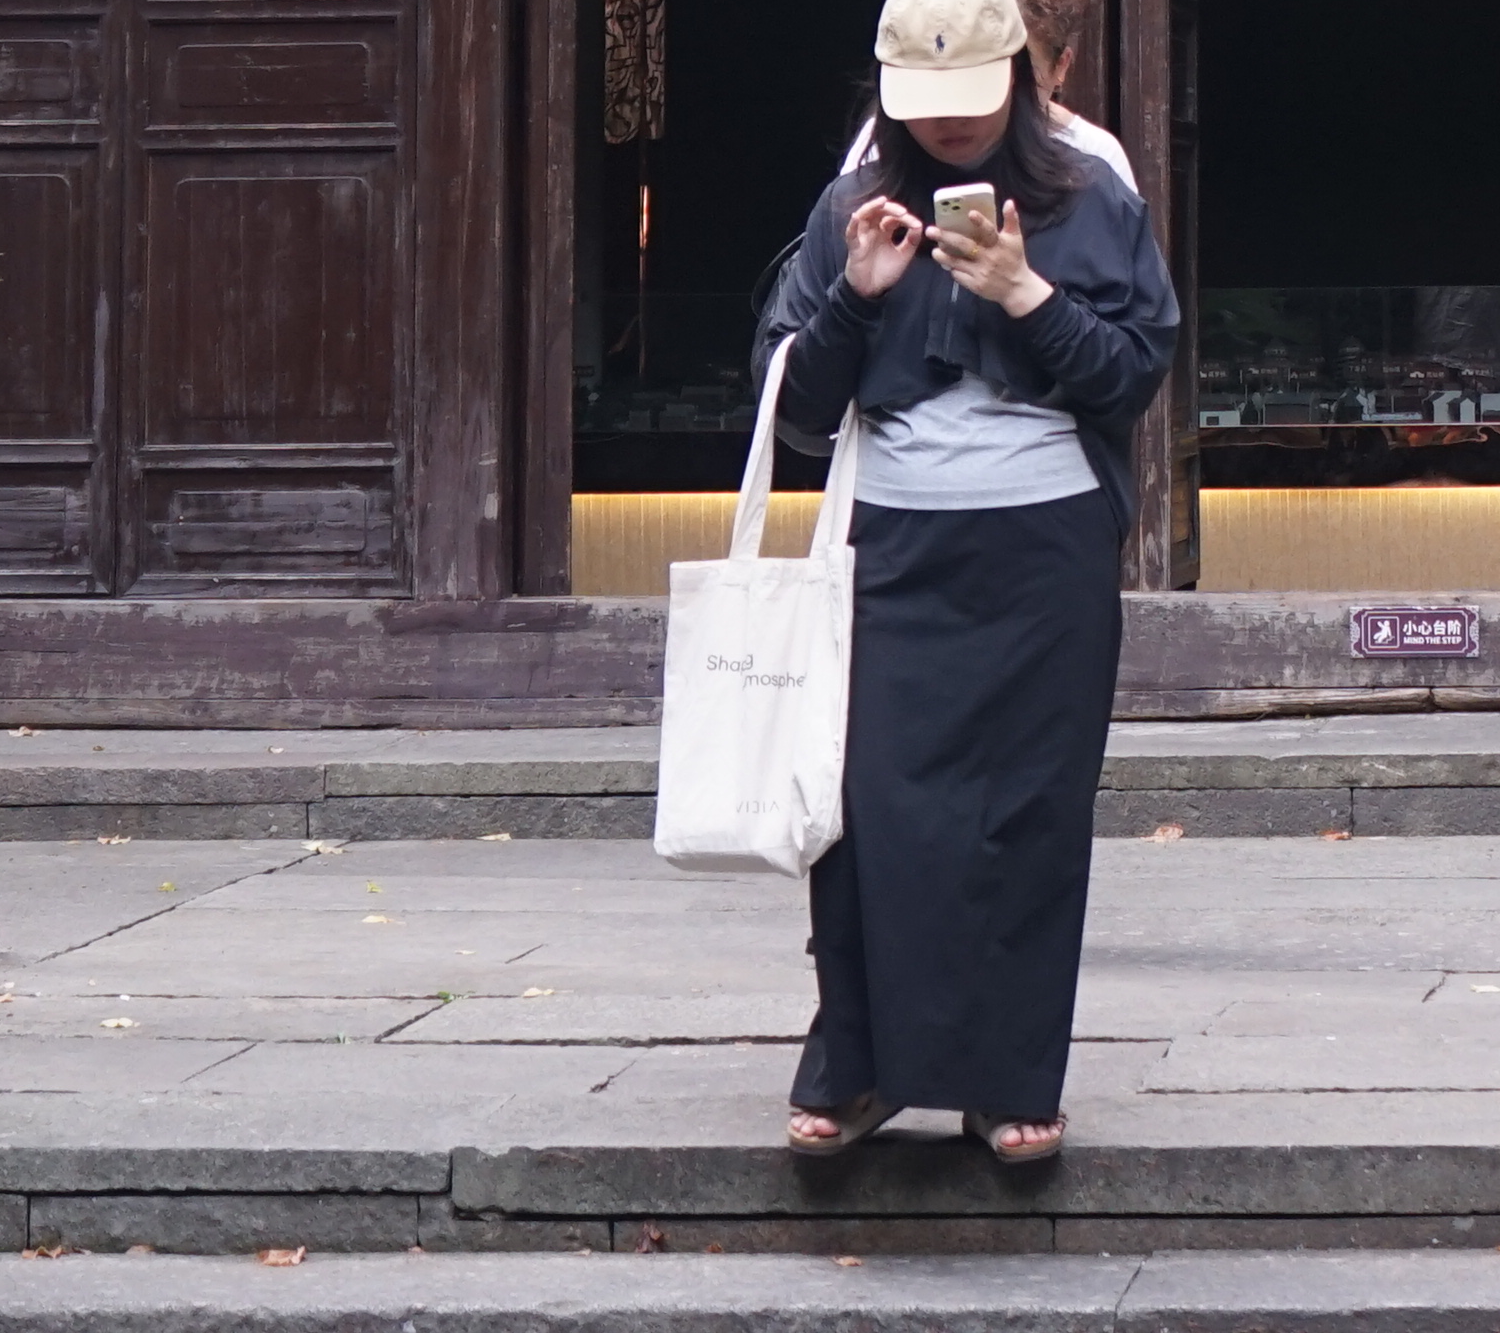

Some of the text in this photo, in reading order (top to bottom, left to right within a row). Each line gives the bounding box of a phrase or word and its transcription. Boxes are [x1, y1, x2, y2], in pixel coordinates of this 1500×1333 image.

[1402, 619, 1462, 635] 小心台阶
[1403, 636, 1462, 645] MIND THE STEP
